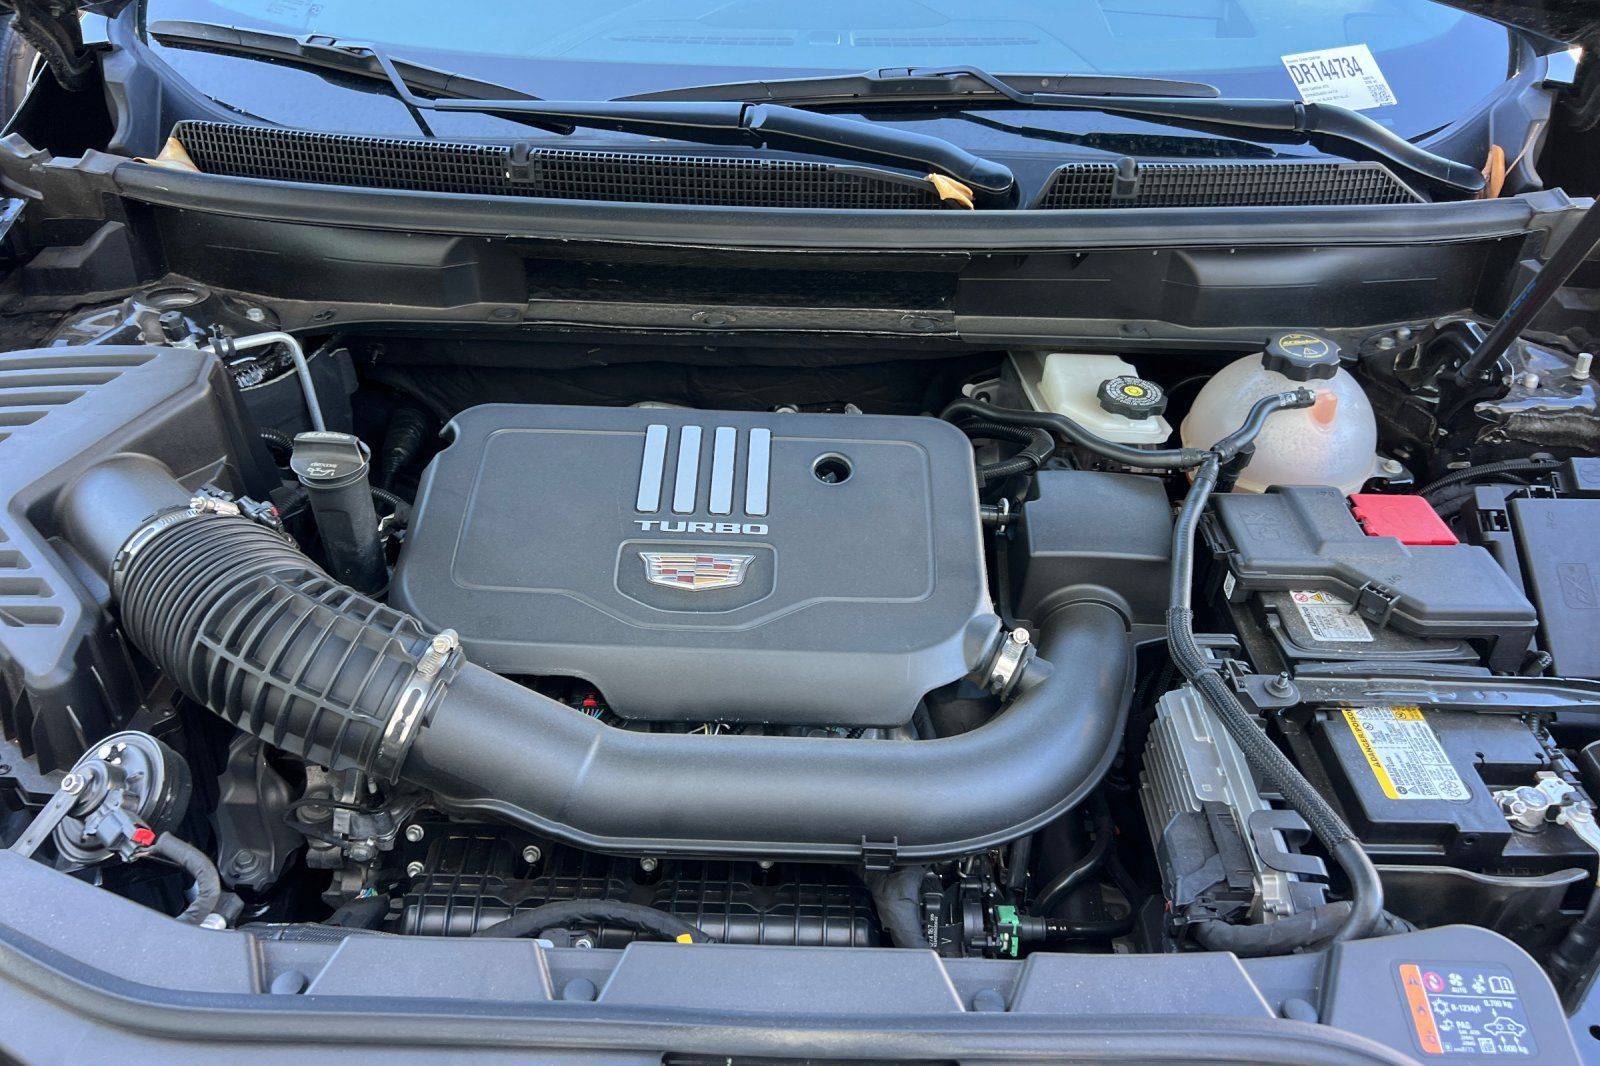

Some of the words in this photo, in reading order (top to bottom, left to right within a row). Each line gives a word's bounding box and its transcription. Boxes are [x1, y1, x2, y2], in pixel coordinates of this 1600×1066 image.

[1289, 56, 1364, 85] DR144734
[633, 520, 769, 535] TURBO
[1302, 606, 1322, 637] ACDelco
[1451, 986, 1468, 994] AUTO
[1503, 1000, 1514, 1010] kg
